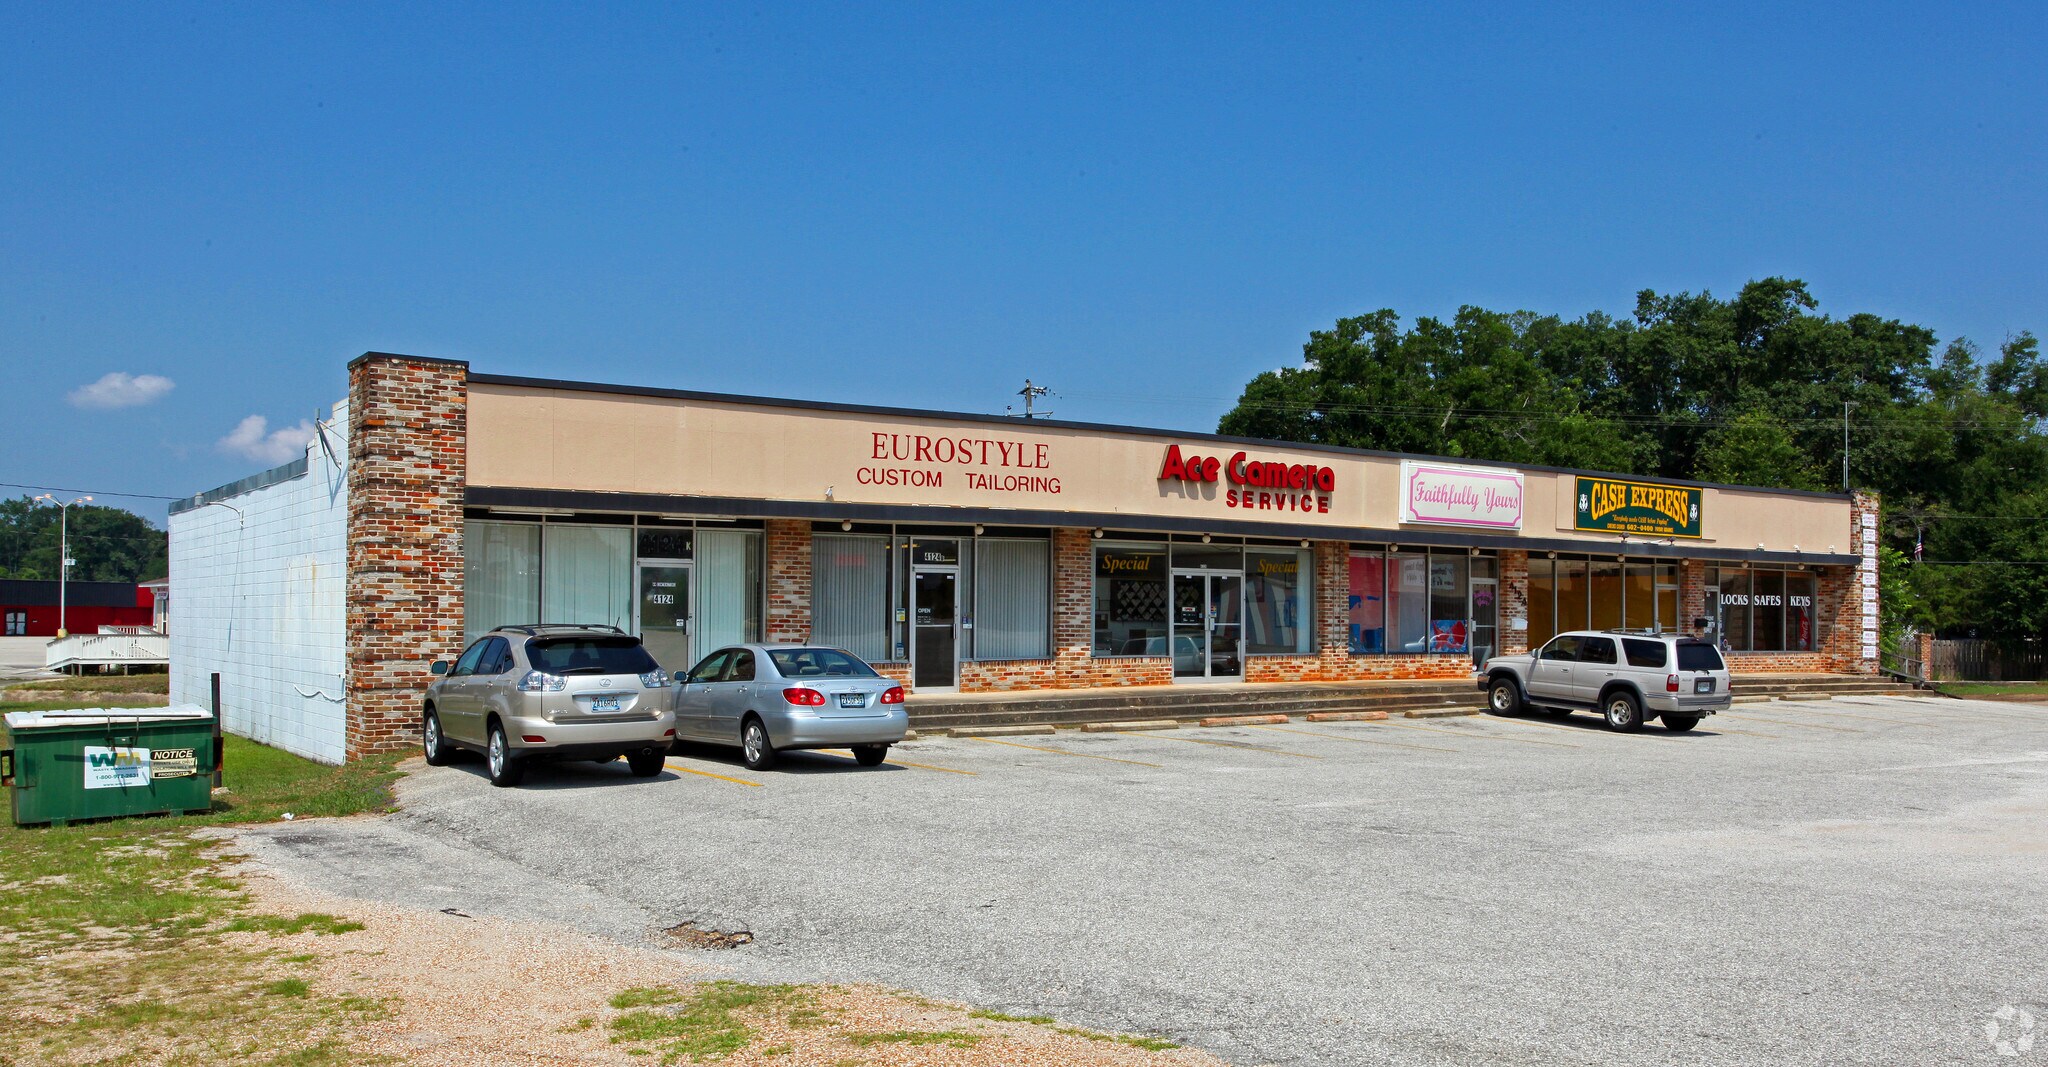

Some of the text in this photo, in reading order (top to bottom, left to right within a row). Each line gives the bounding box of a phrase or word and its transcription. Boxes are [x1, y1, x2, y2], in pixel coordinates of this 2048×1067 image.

[871, 432, 1050, 469] EUROSTYLE
[1157, 444, 1335, 491] Ace Camera
[856, 467, 1061, 494] CUSTOM TAILORING
[1226, 489, 1329, 513] SERVICE
[1414, 481, 1519, 514] Faithfully Yours
[1591, 482, 1689, 528] CASH EXPRESS
[1102, 554, 1150, 574] Special
[1256, 559, 1299, 576] Special
[653, 595, 673, 604] 4124
[1720, 594, 1748, 605] LOCKS
[1754, 595, 1781, 606] SAFES
[1790, 596, 1811, 606] KEYS
[153, 750, 193, 759] NOTICE
